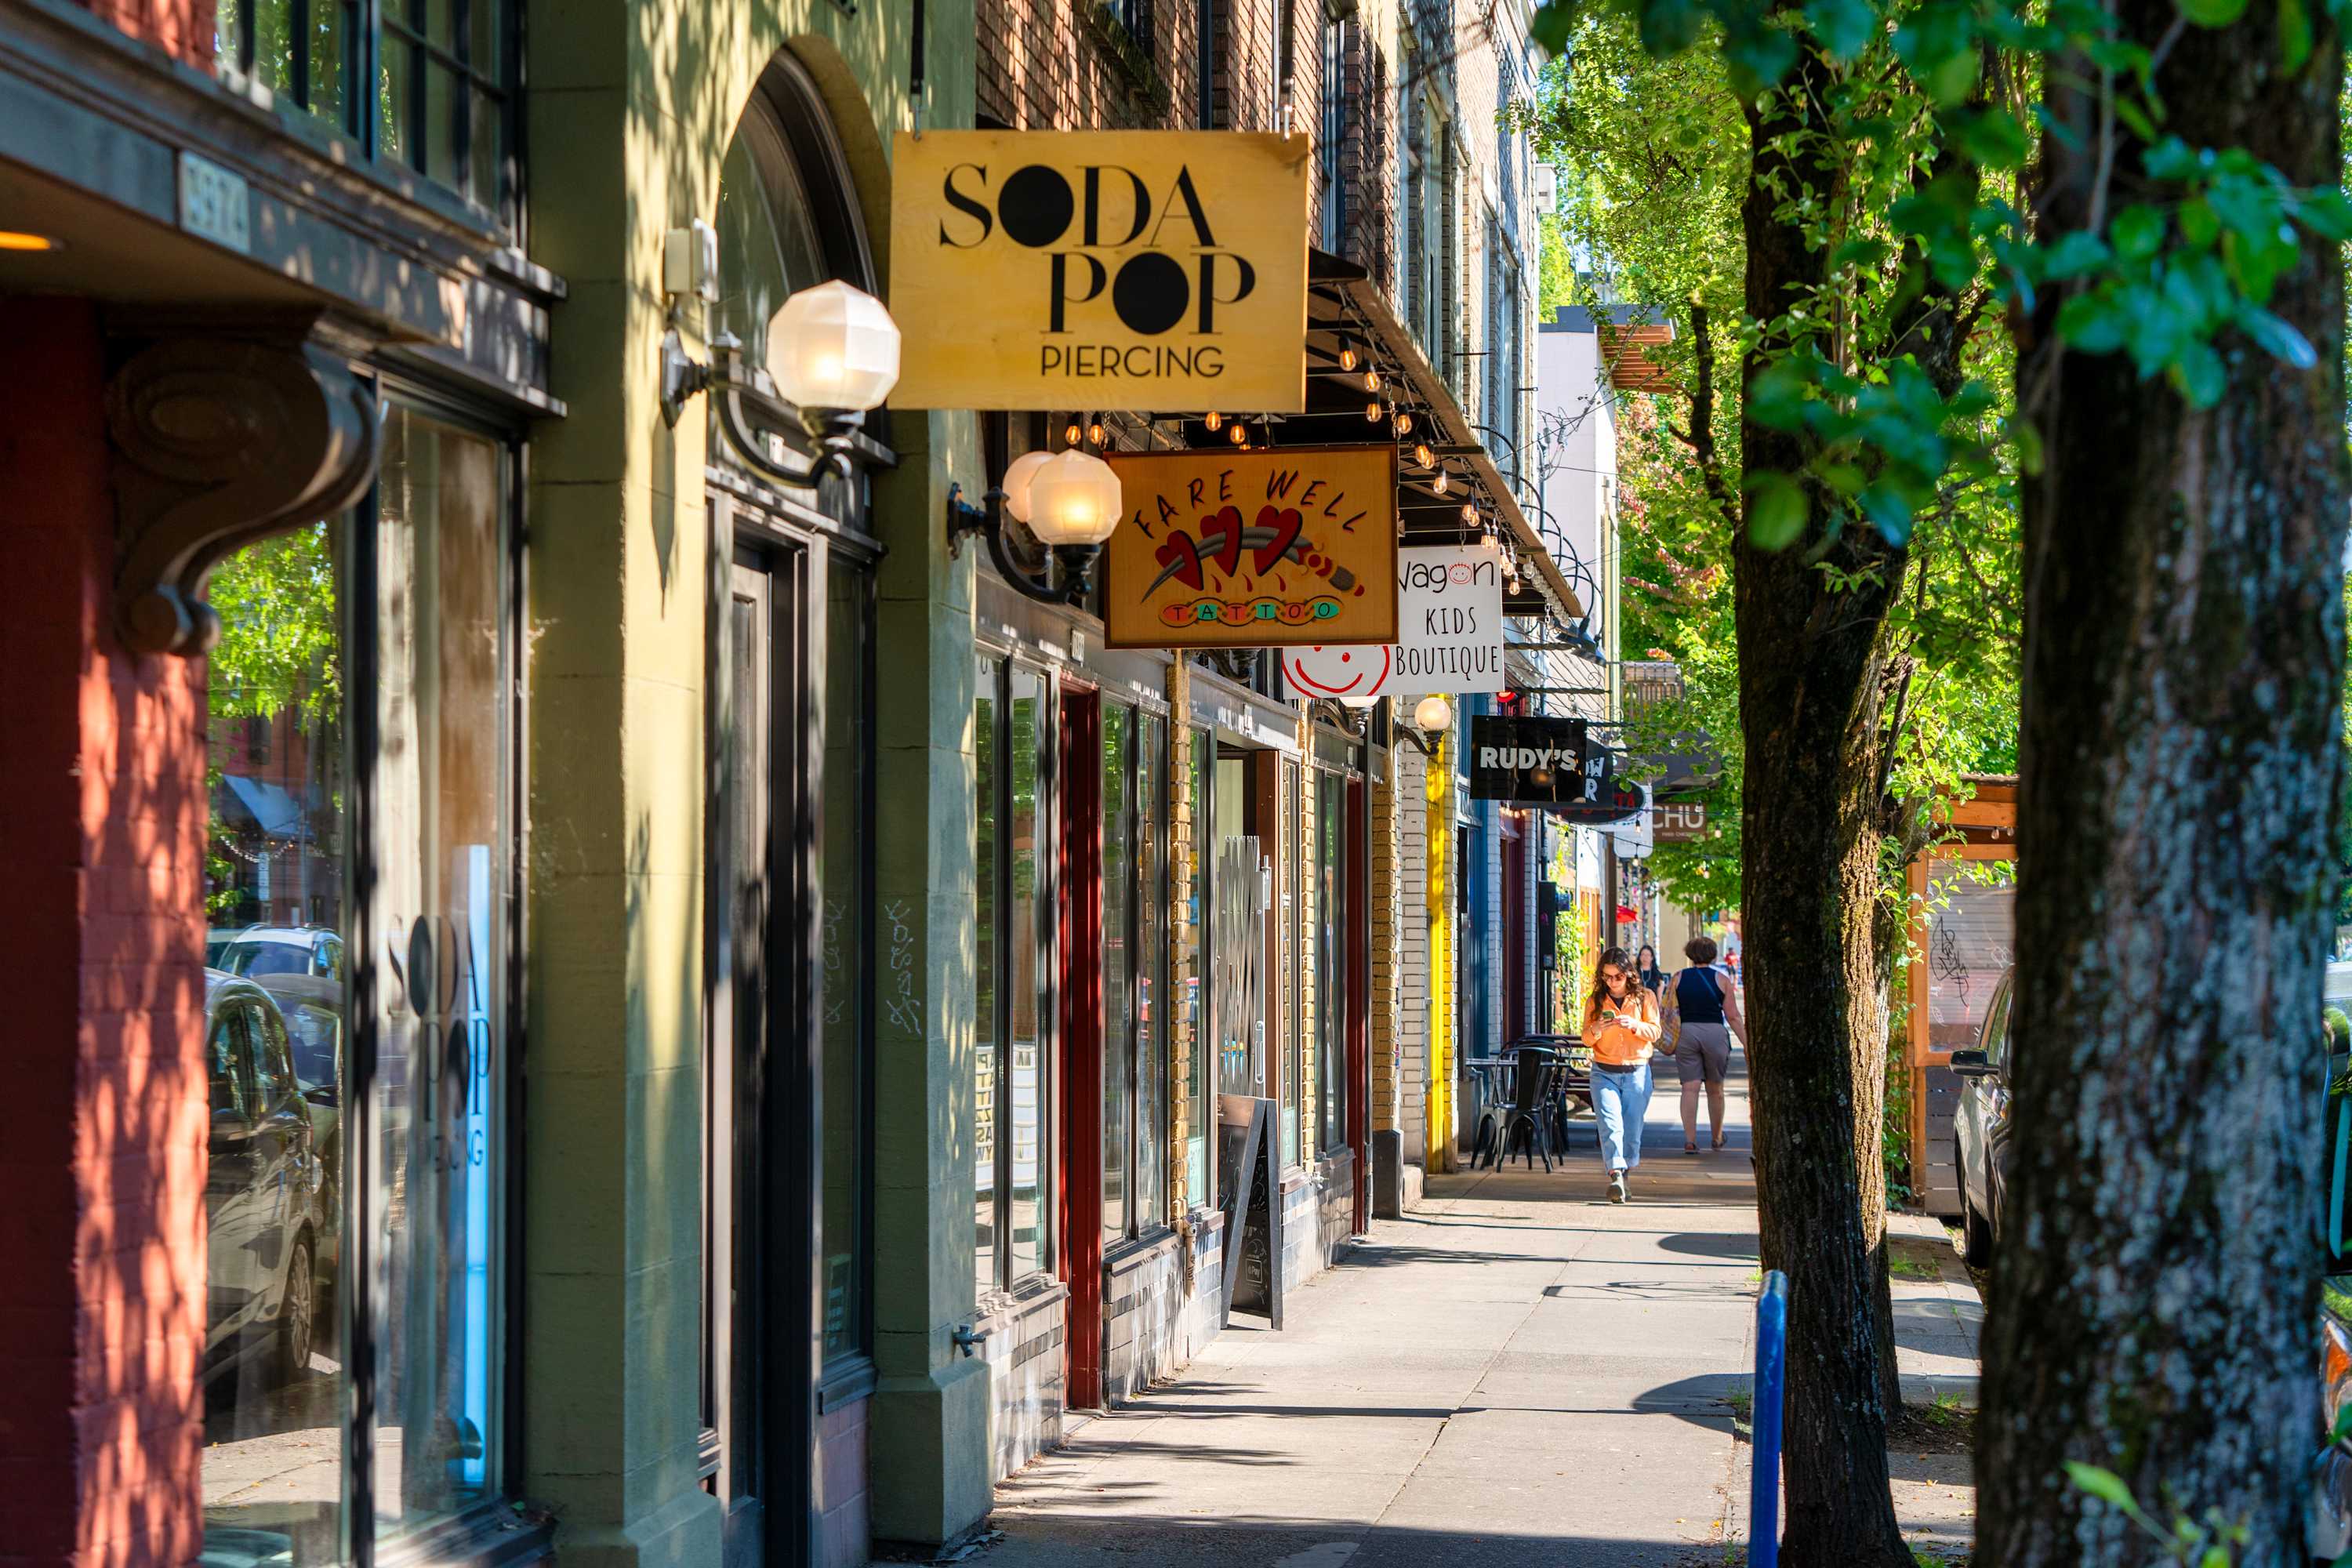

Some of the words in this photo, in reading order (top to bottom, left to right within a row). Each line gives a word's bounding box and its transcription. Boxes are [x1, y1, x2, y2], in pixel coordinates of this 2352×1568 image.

[940, 163, 1225, 249] SODA
[1040, 251, 1256, 336] POP
[1041, 346, 1225, 377] PIERCING
[1172, 602, 1331, 622] TATTOO
[1426, 607, 1477, 636] KIDS
[1396, 645, 1499, 681] BOUTIQUE
[1479, 746, 1577, 771] RUDY'S
